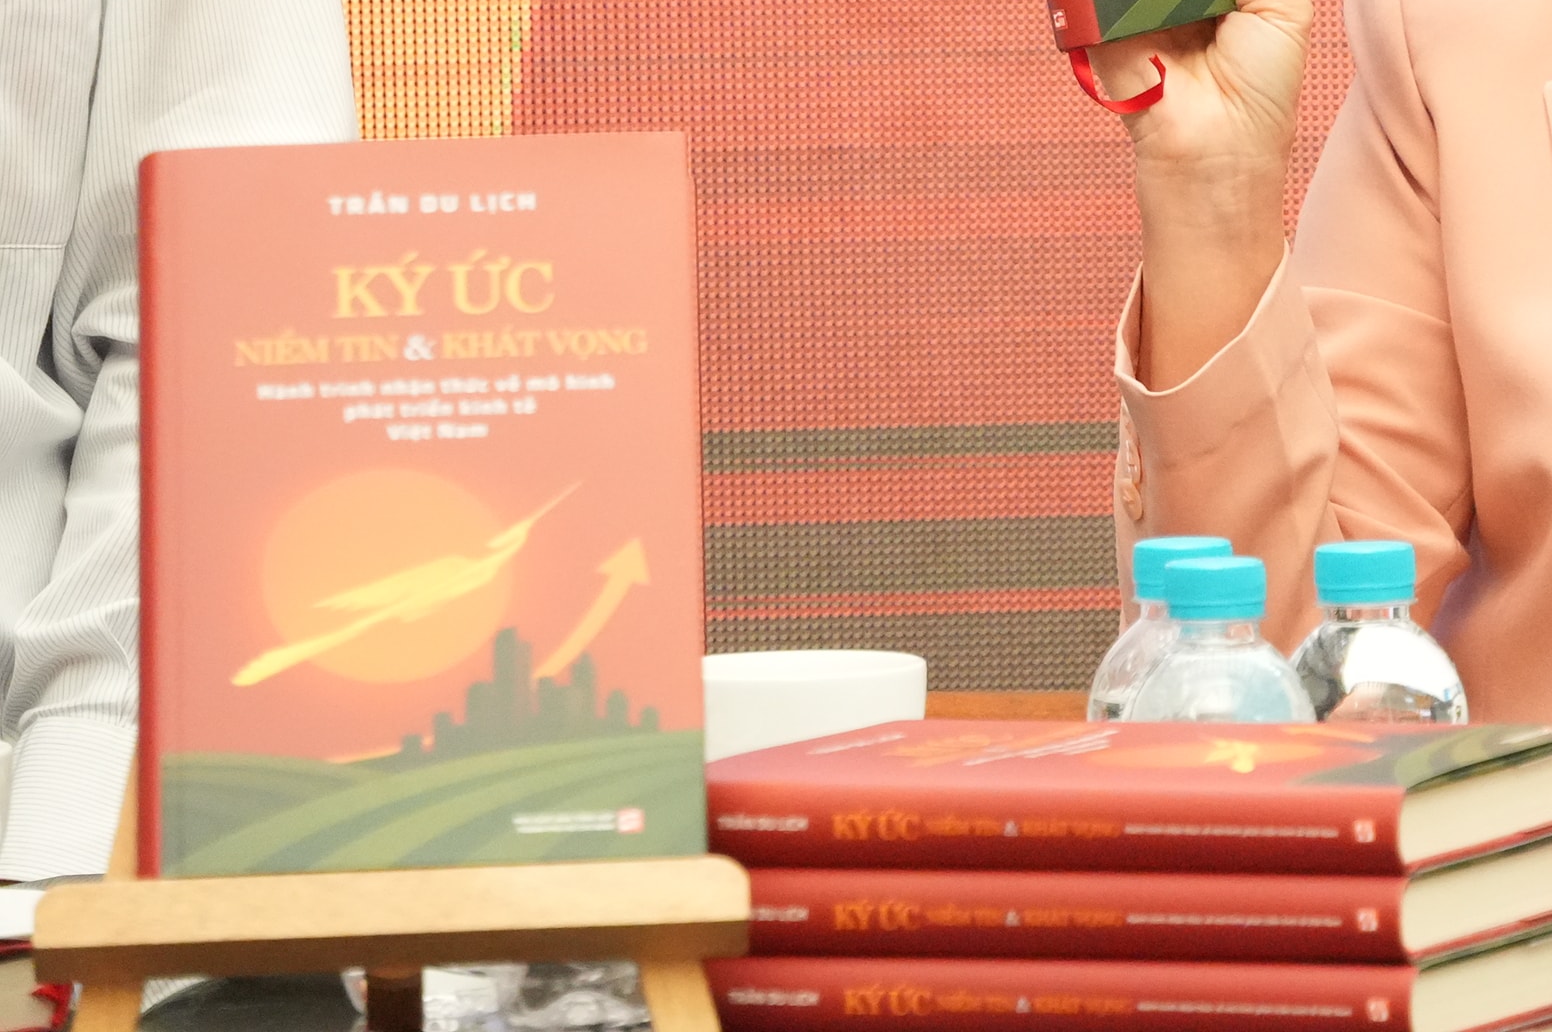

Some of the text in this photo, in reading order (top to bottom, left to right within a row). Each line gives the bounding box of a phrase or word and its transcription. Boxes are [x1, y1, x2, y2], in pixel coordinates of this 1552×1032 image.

[419, 194, 459, 214] DU
[332, 248, 556, 319] KÝ ỨC
[335, 334, 401, 363] TIN
[403, 333, 436, 361] &
[440, 325, 543, 360] KHÁT
[545, 328, 648, 361] VỌNG
